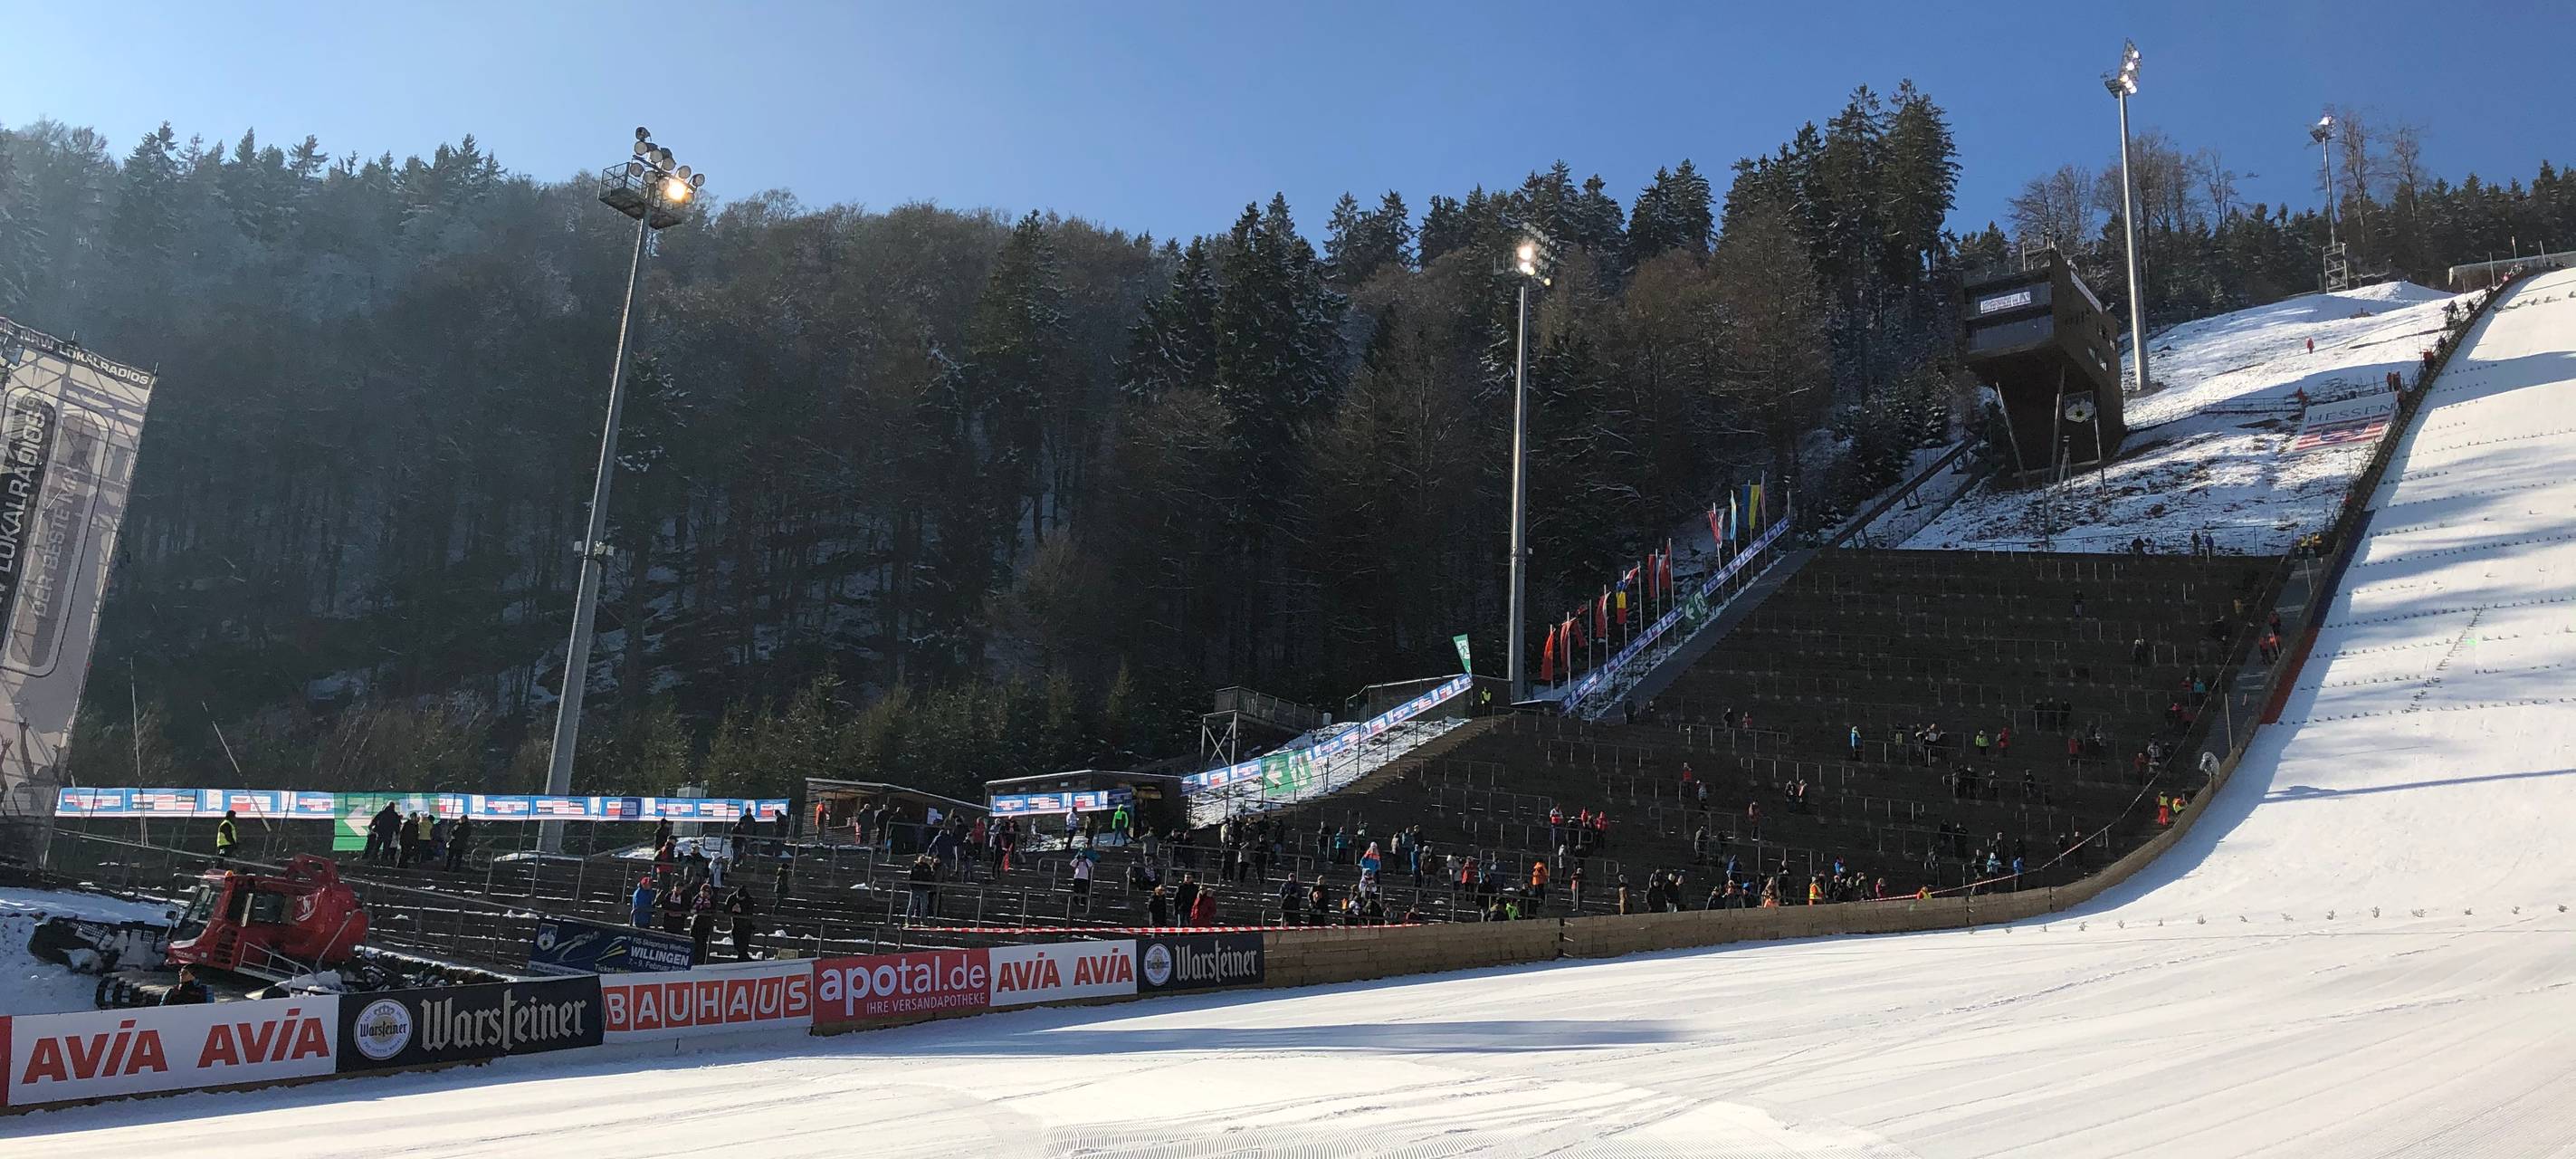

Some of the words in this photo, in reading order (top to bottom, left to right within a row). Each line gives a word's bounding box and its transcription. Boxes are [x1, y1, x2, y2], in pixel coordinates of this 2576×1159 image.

[59, 343, 149, 385] LOKALRADIOS
[2308, 402, 2394, 423] HESSEN
[43, 508, 71, 570] BESTE
[631, 945, 690, 967] WILLINGEN
[1175, 939, 1257, 982] Warsteiner
[607, 981, 808, 1025] BAUHAUS
[819, 953, 986, 1016] apotal.de
[866, 1001, 889, 1015] IHRE
[892, 992, 986, 1012] VERSANDAPOTHEKE
[359, 1020, 408, 1038] Warsteiner
[419, 988, 587, 1051] Warsteiner
